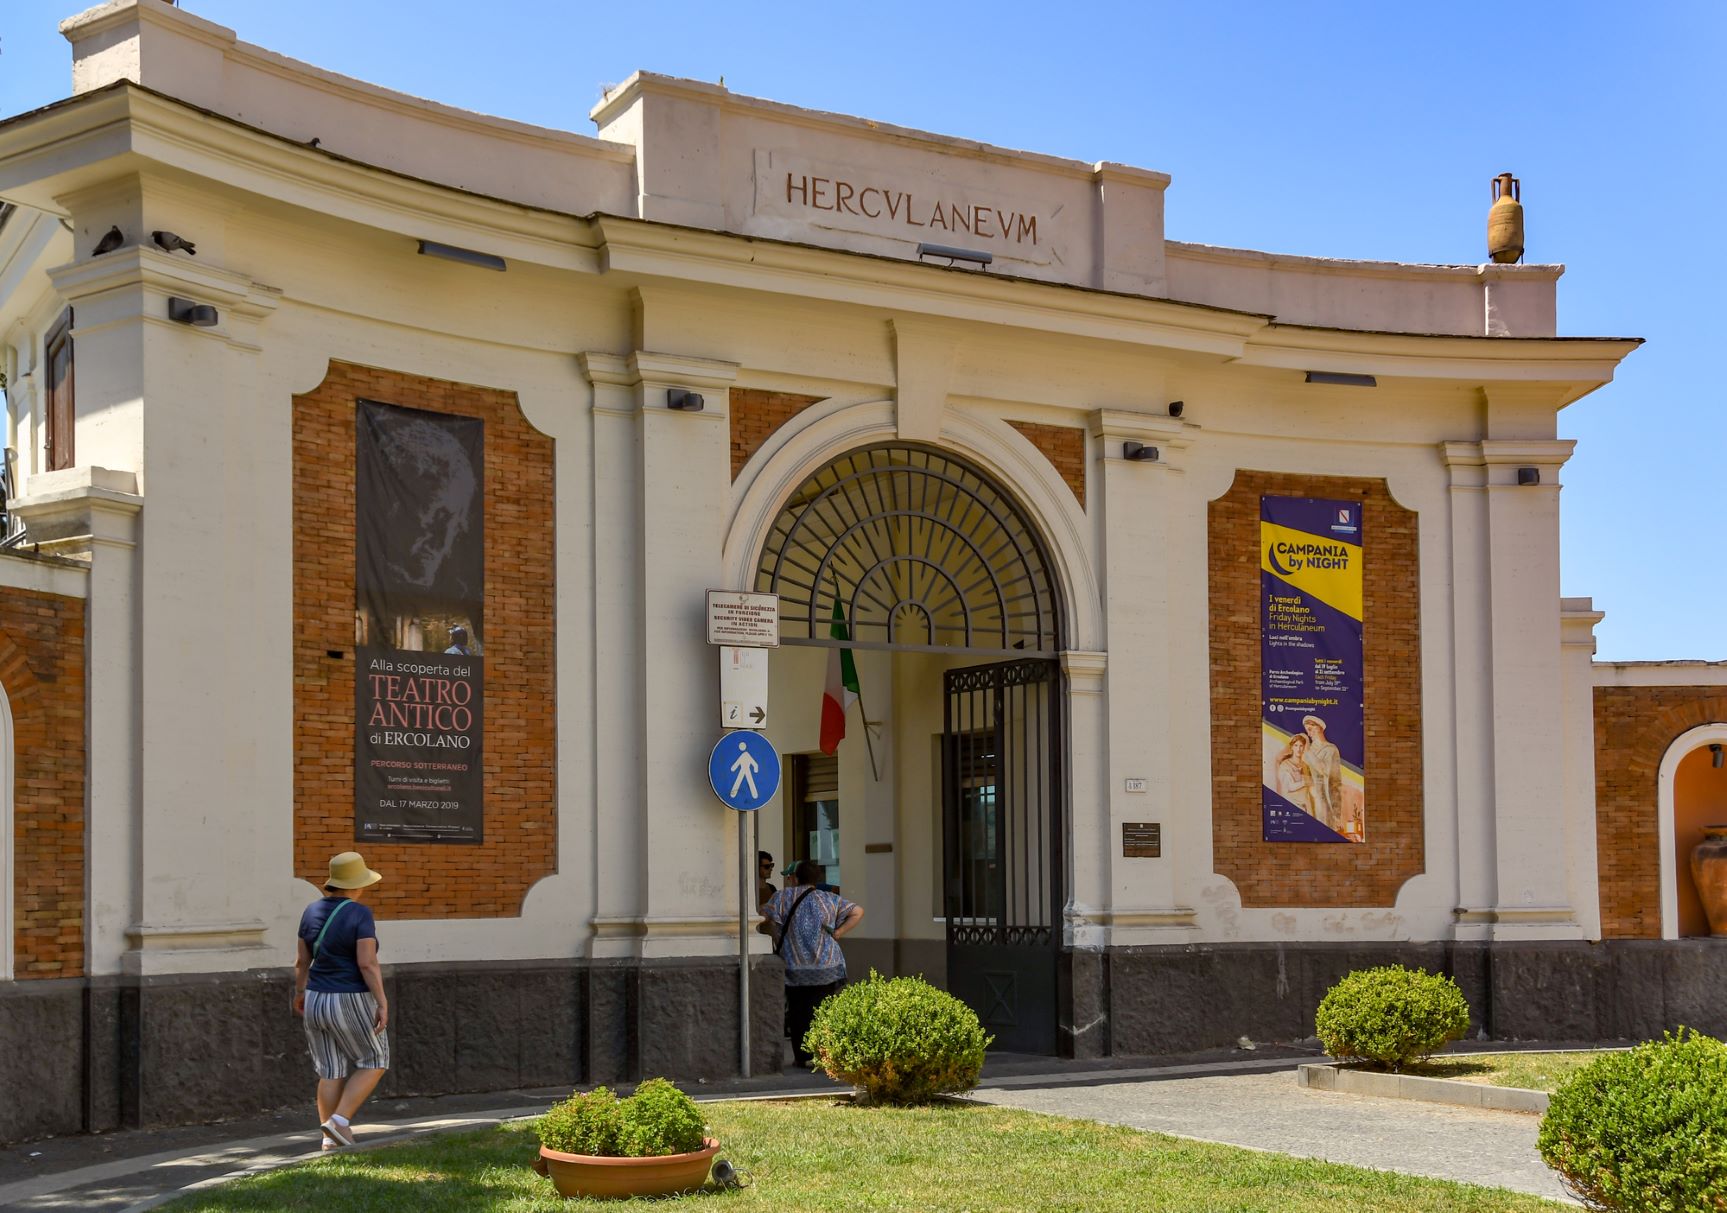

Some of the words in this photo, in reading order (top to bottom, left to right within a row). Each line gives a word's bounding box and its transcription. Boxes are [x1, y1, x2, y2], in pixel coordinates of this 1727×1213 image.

[786, 173, 1037, 245] HERCVLANEVM
[1276, 542, 1348, 557] CAMPANIA
[1288, 555, 1303, 571] by
[1306, 557, 1349, 570] NIGHT
[1269, 594, 1273, 602] I
[1269, 604, 1277, 612] di
[1278, 604, 1310, 613] Ercolano
[1269, 612, 1291, 624] Friday
[1292, 614, 1316, 623] Nights
[1277, 622, 1326, 632] Herculaneum
[370, 658, 393, 671] Alla
[397, 662, 450, 676] scoperta
[453, 665, 471, 677] del
[369, 674, 472, 705] TEATRO
[368, 701, 472, 731] ANTICO
[370, 733, 381, 744] di
[384, 731, 471, 749] ERCOLANO
[371, 760, 412, 769] PERCORSO
[413, 761, 468, 771] SOTTERRANEO
[379, 799, 398, 808] DAL
[400, 800, 408, 808] 17
[408, 800, 439, 809] MARZO
[441, 801, 460, 810] 2019
